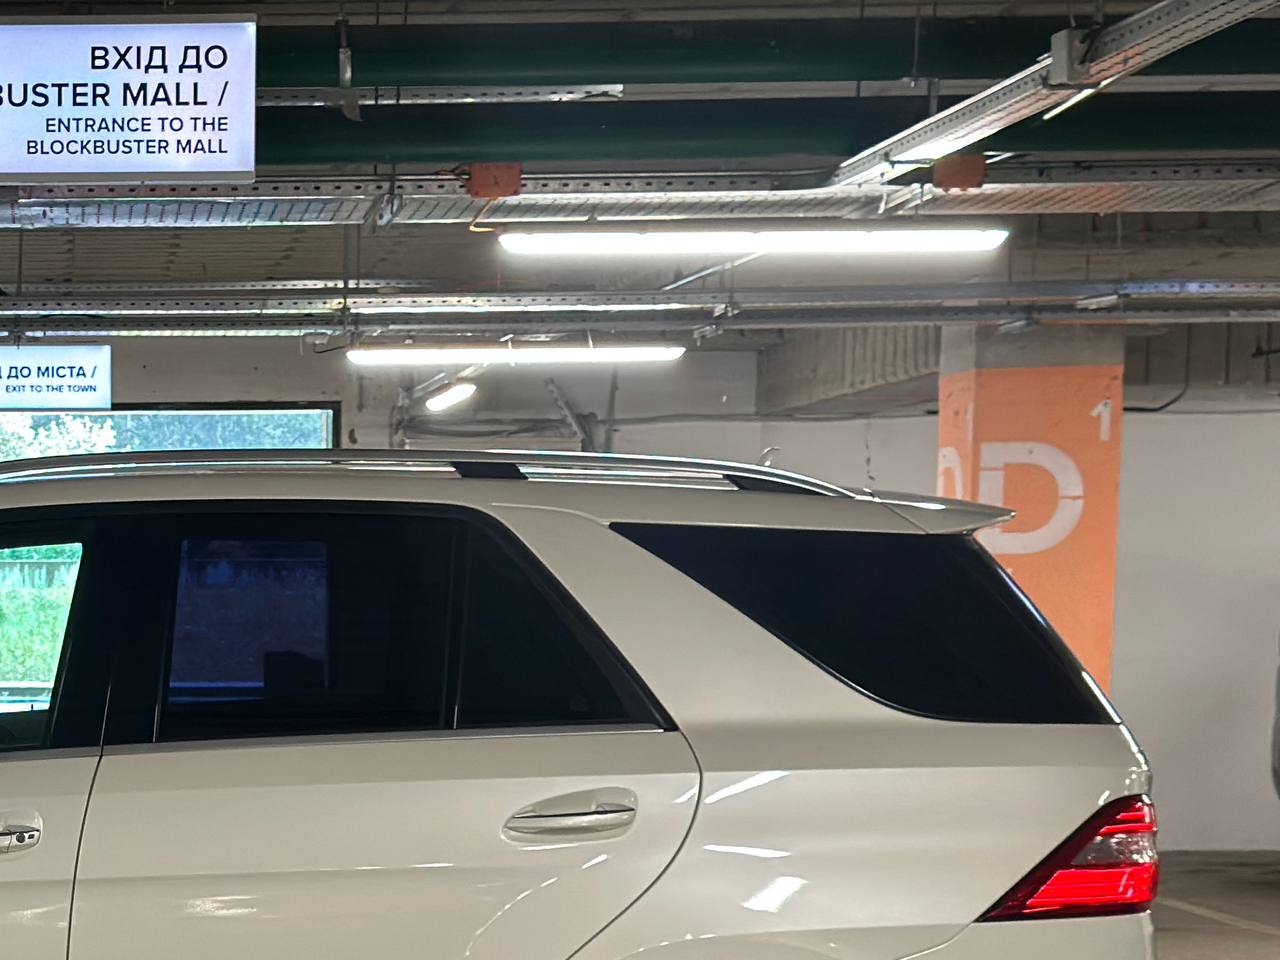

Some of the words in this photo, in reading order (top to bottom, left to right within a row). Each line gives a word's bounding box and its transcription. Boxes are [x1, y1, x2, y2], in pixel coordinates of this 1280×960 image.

[90, 45, 168, 74] ВХІД
[178, 44, 228, 74] ДО
[122, 81, 208, 107] MALL
[45, 116, 152, 133] ENTRANCE
[157, 116, 184, 133] TO
[189, 116, 229, 132] THE
[26, 138, 170, 155] BLOCKBUSTER
[176, 138, 229, 154] MALL
[6, 365, 32, 380] ДО
[36, 365, 87, 379] МІСТА
[5, 384, 27, 394] EXIT
[29, 384, 44, 393] TO
[45, 384, 65, 393] THE
[66, 384, 97, 393] TOWN
[1089, 399, 1112, 441] 1
[974, 441, 1084, 554] D
